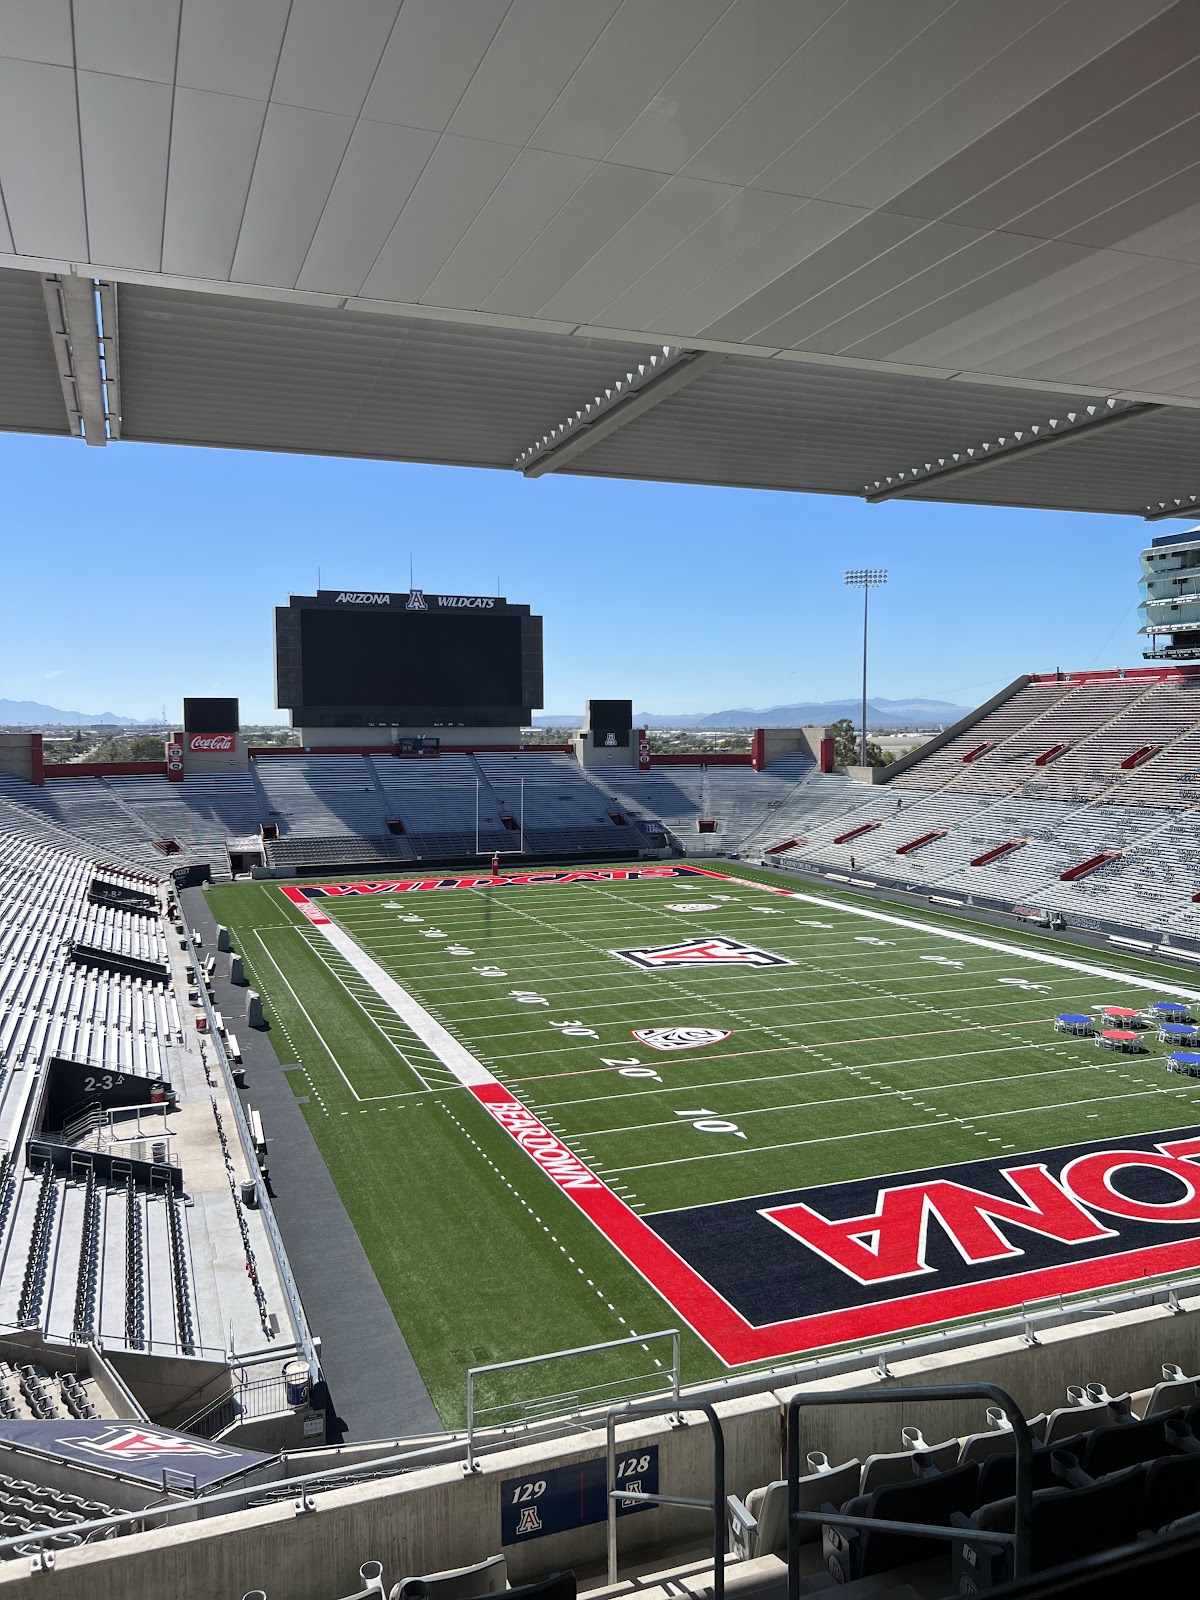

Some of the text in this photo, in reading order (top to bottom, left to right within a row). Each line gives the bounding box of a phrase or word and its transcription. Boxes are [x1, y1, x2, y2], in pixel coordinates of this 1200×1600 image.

[335, 592, 390, 605] ARIZONA
[438, 597, 495, 609] WILDCATS
[190, 735, 233, 750] Coca-Cola
[313, 868, 679, 898] WILDCATS
[472, 965, 508, 977] 50
[508, 990, 548, 1003] 40
[549, 1020, 597, 1037] 30
[599, 1057, 659, 1079] 20
[84, 1074, 114, 1092] 2-3
[673, 1107, 740, 1133] 10
[615, 1454, 651, 1479] 128
[511, 1479, 547, 1504] 129
